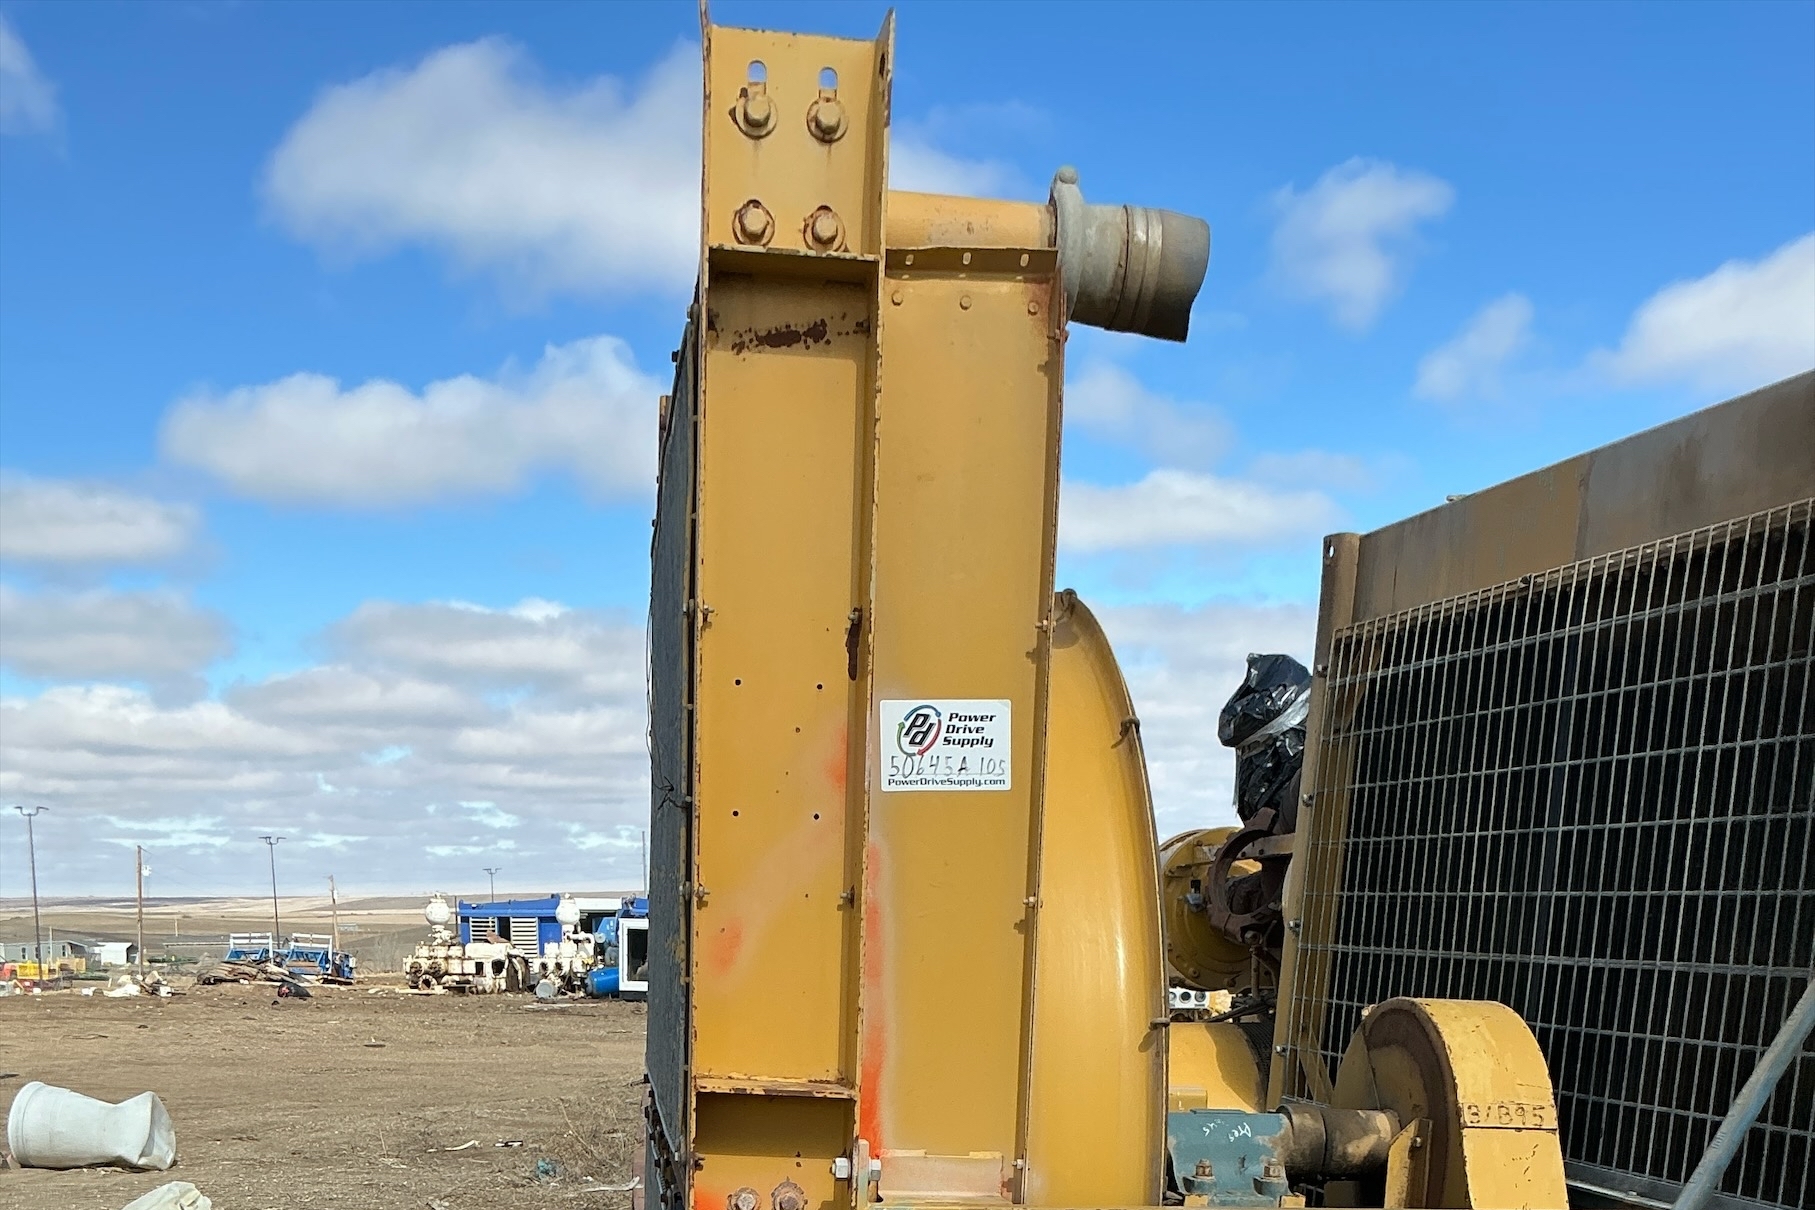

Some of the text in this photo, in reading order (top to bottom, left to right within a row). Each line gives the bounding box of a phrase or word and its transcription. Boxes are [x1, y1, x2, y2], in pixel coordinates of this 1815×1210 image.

[948, 712, 997, 722] Power
[945, 724, 985, 734] Drive
[942, 736, 994, 748] Supply
[888, 778, 1006, 787] PowerDriveSupply.com
